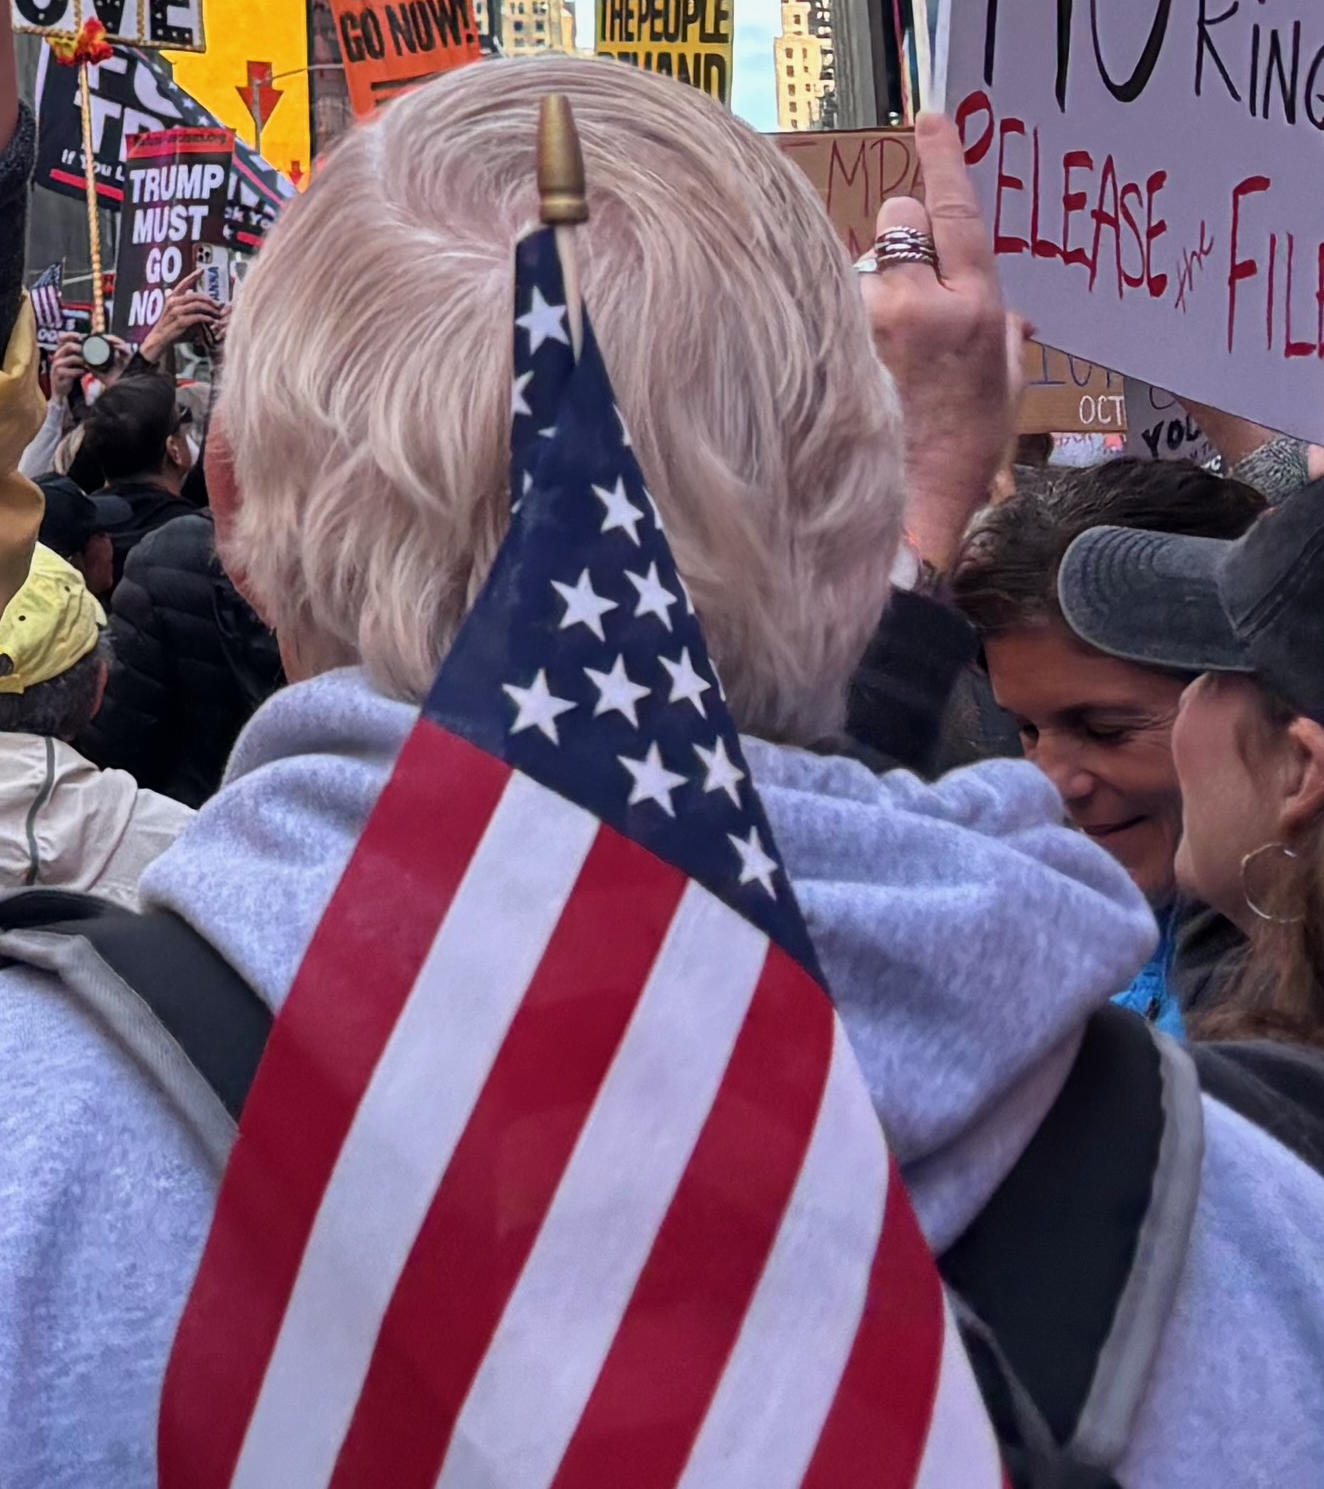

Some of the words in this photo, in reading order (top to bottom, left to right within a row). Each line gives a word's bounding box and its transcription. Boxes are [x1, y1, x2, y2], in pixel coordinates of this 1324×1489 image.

[340, 9, 387, 64] GO
[129, 163, 225, 203] TRUMP
[132, 205, 210, 245] MUST
[145, 245, 183, 283] GO
[127, 288, 166, 327] NO
